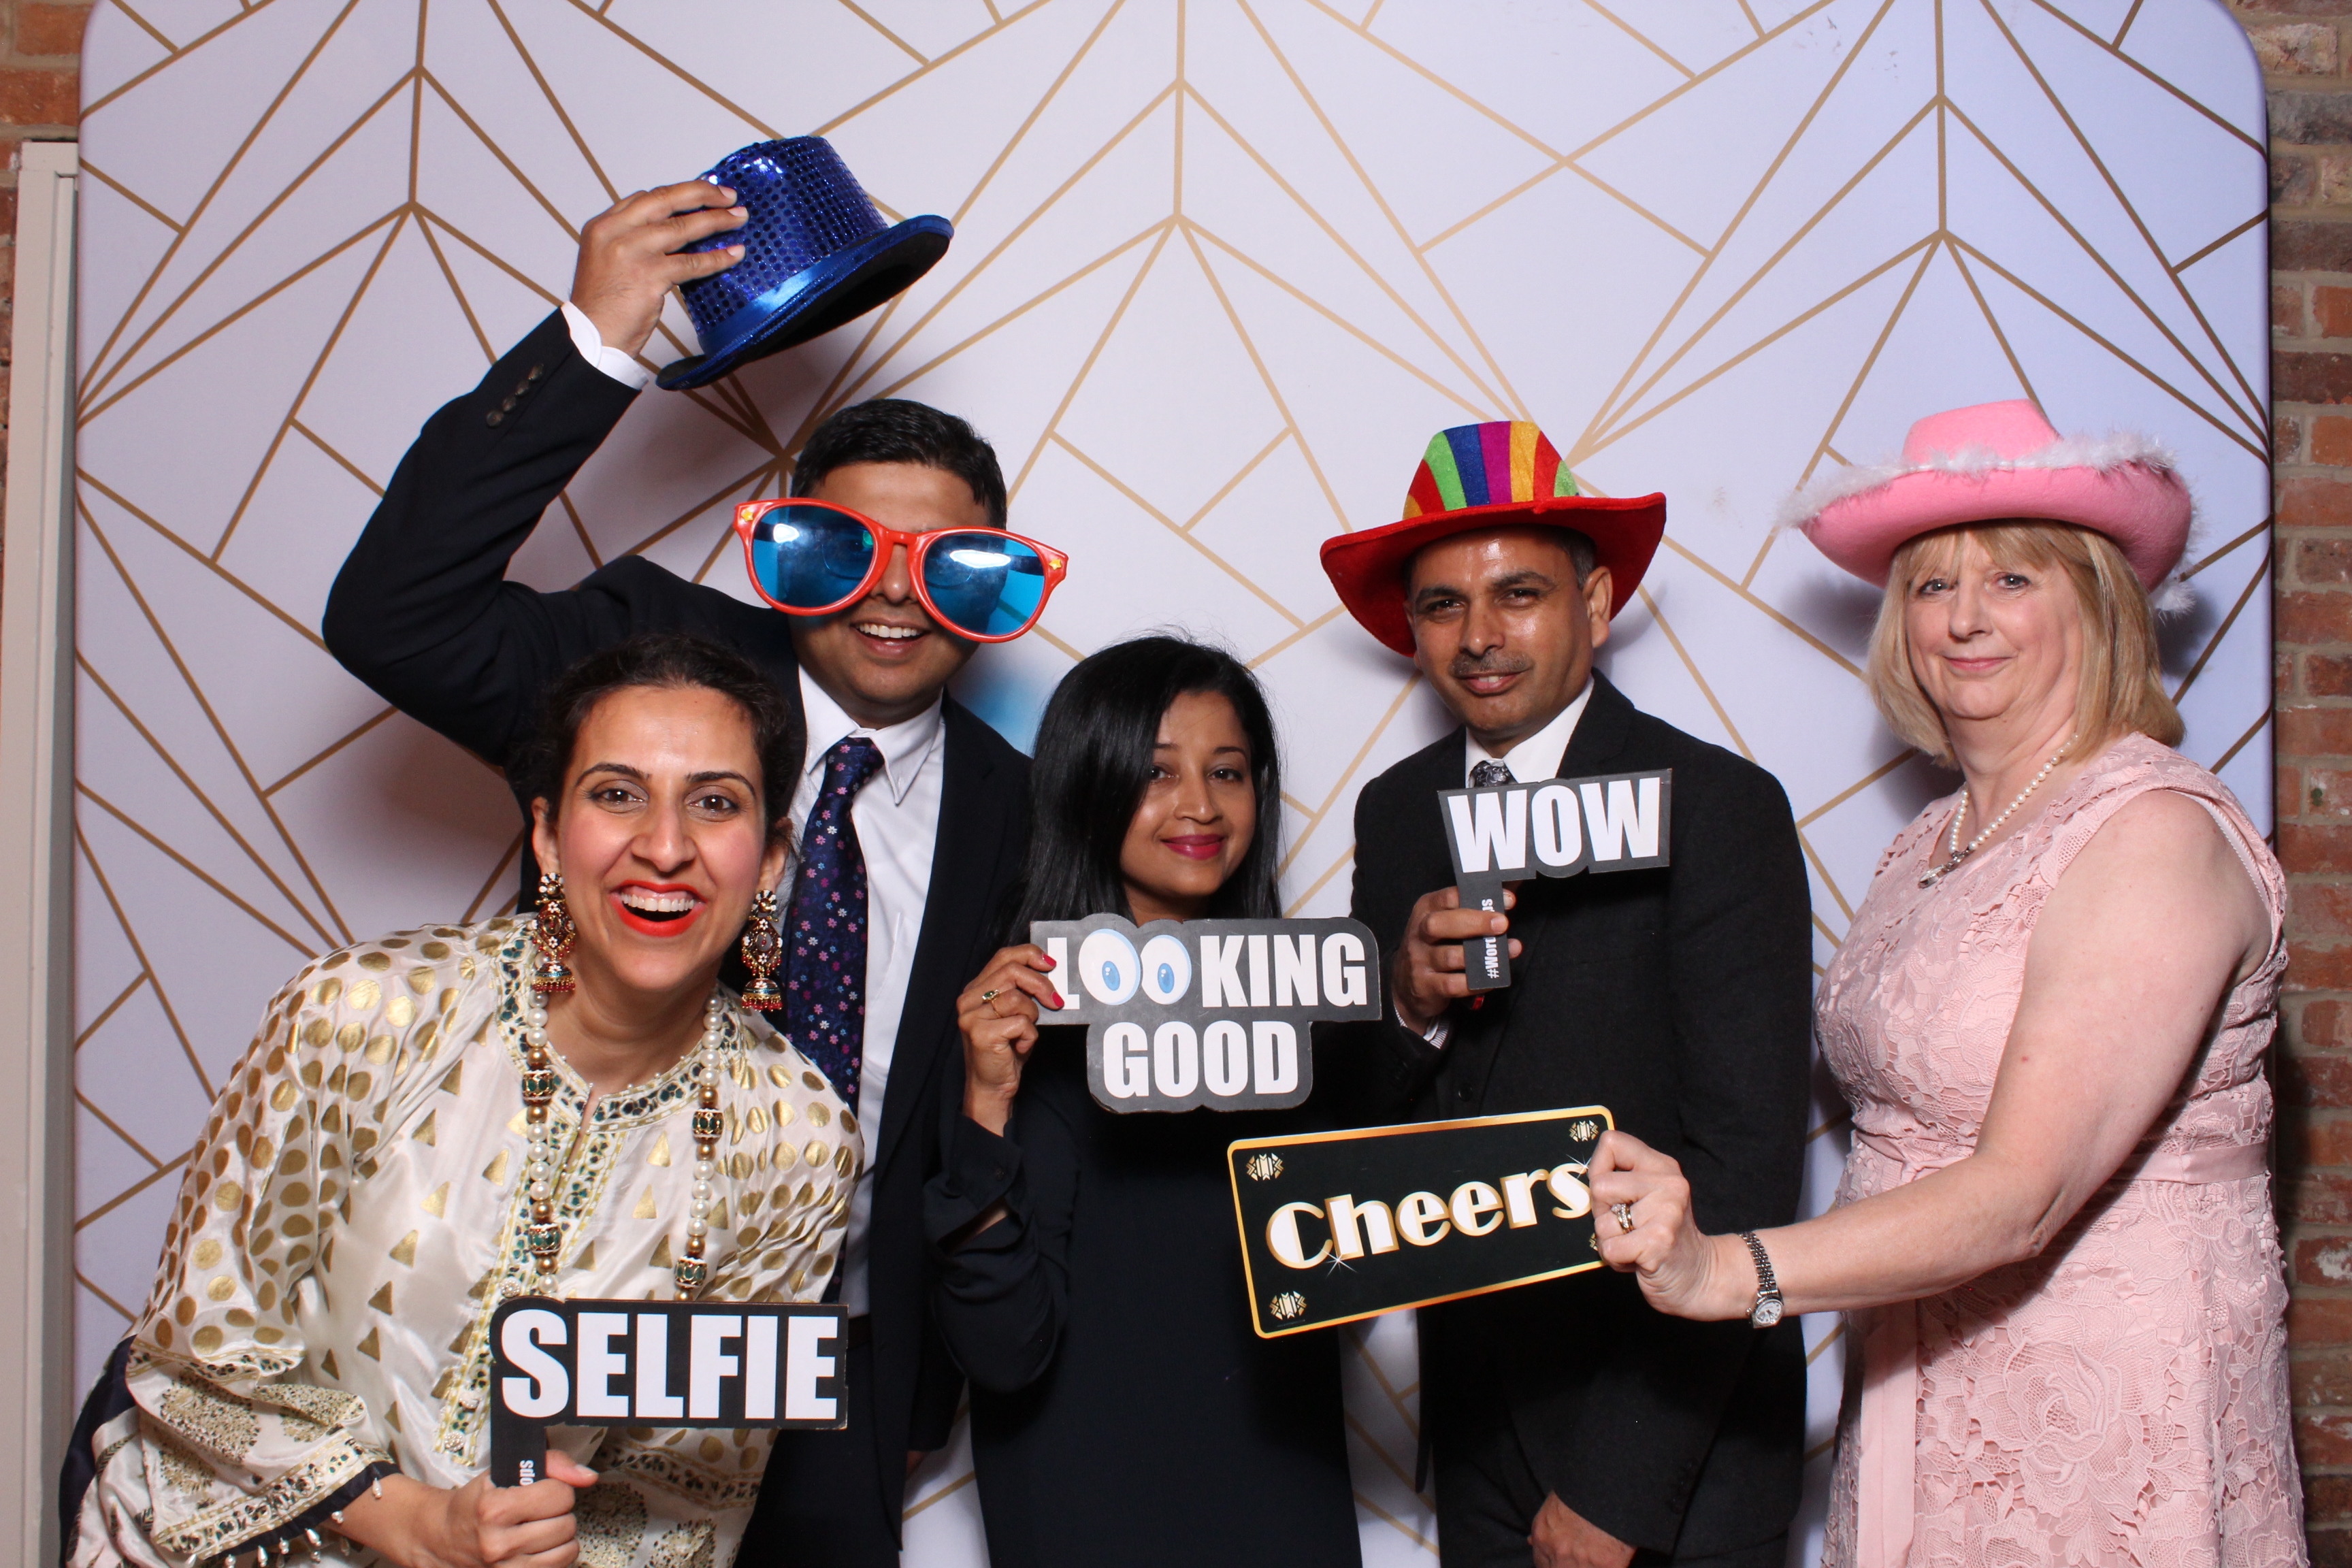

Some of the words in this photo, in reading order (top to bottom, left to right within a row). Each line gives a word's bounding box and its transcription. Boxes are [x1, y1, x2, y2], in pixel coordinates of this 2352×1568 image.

[1447, 777, 1661, 874] WOW
[1047, 928, 1368, 1010] LOOKING
[1481, 898, 1500, 979] #Wordps
[1102, 1020, 1299, 1098] GOOD
[1265, 1162, 1592, 1270] Cheers
[501, 1308, 838, 1420] SELFIE
